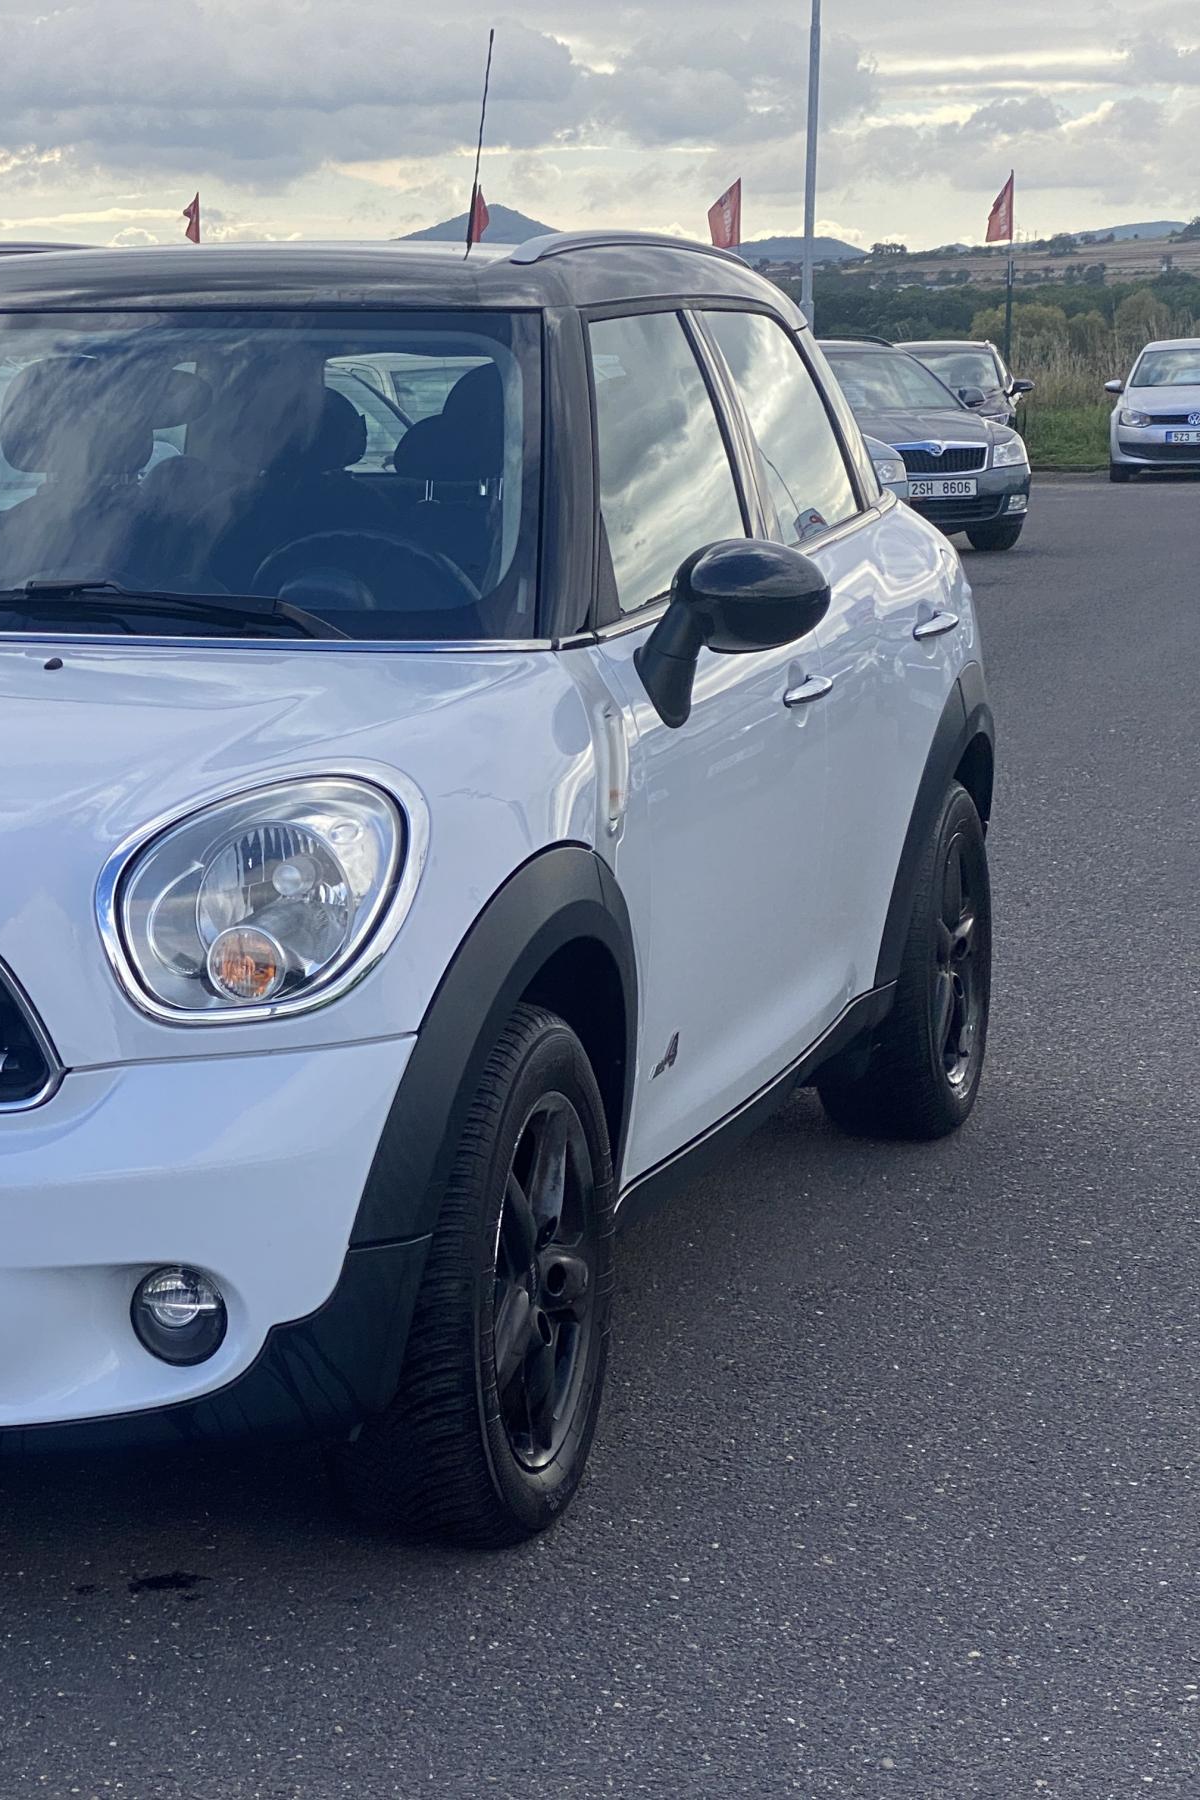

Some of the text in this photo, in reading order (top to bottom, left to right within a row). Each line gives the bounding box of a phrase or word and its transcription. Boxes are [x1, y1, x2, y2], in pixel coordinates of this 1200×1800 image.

[1173, 433, 1190, 441] 5Z3
[911, 481, 971, 495] 2SH 8606
